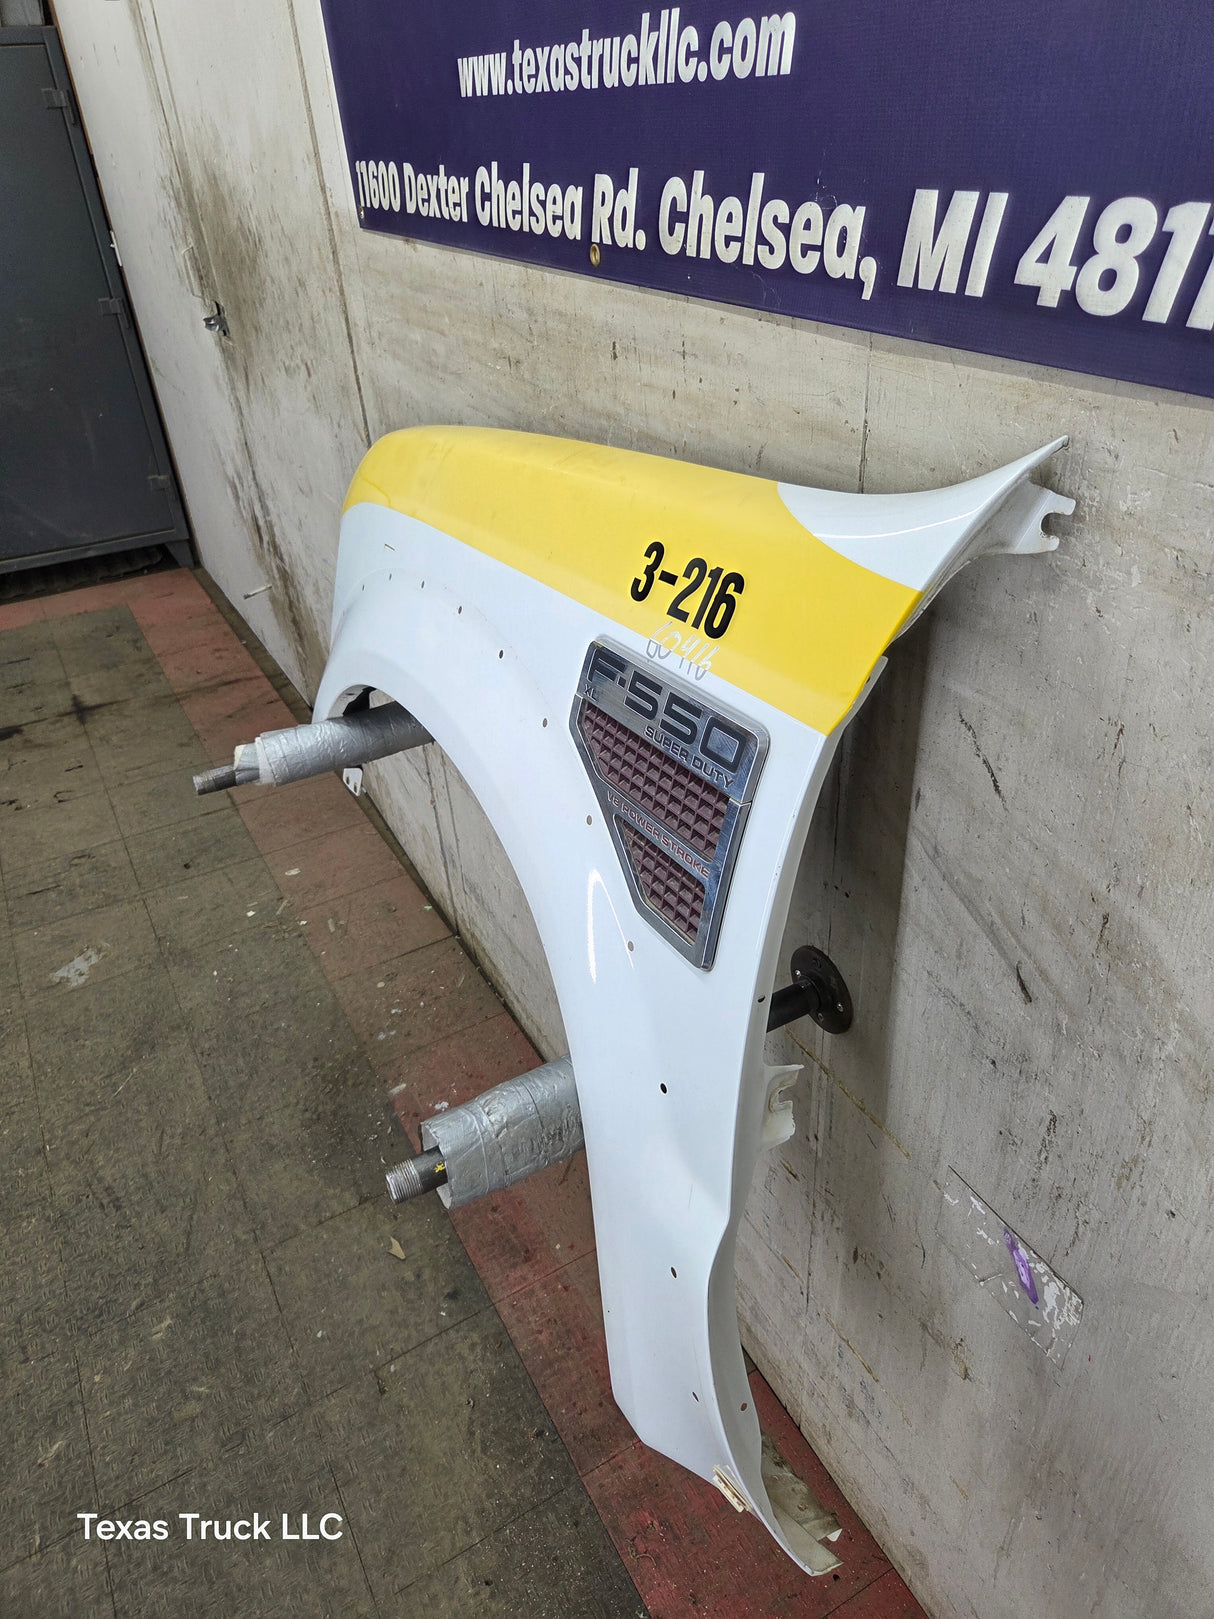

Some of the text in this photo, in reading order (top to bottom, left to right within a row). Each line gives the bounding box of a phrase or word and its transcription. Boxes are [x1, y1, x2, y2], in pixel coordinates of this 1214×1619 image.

[457, 8, 797, 98] www.texastruckllc.com
[355, 160, 401, 213] 11600
[402, 162, 469, 223] Dexter
[474, 161, 583, 241] Chelsea
[592, 167, 647, 251] Rd.
[658, 170, 878, 301] Chelsea,
[896, 188, 1009, 298] MI
[630, 541, 745, 640] 3-216
[583, 683, 600, 703] XL
[587, 647, 748, 774] F-550
[643, 724, 735, 789] SUPER DUTY
[620, 802, 661, 841] POWER
[659, 833, 712, 881] STROKE
